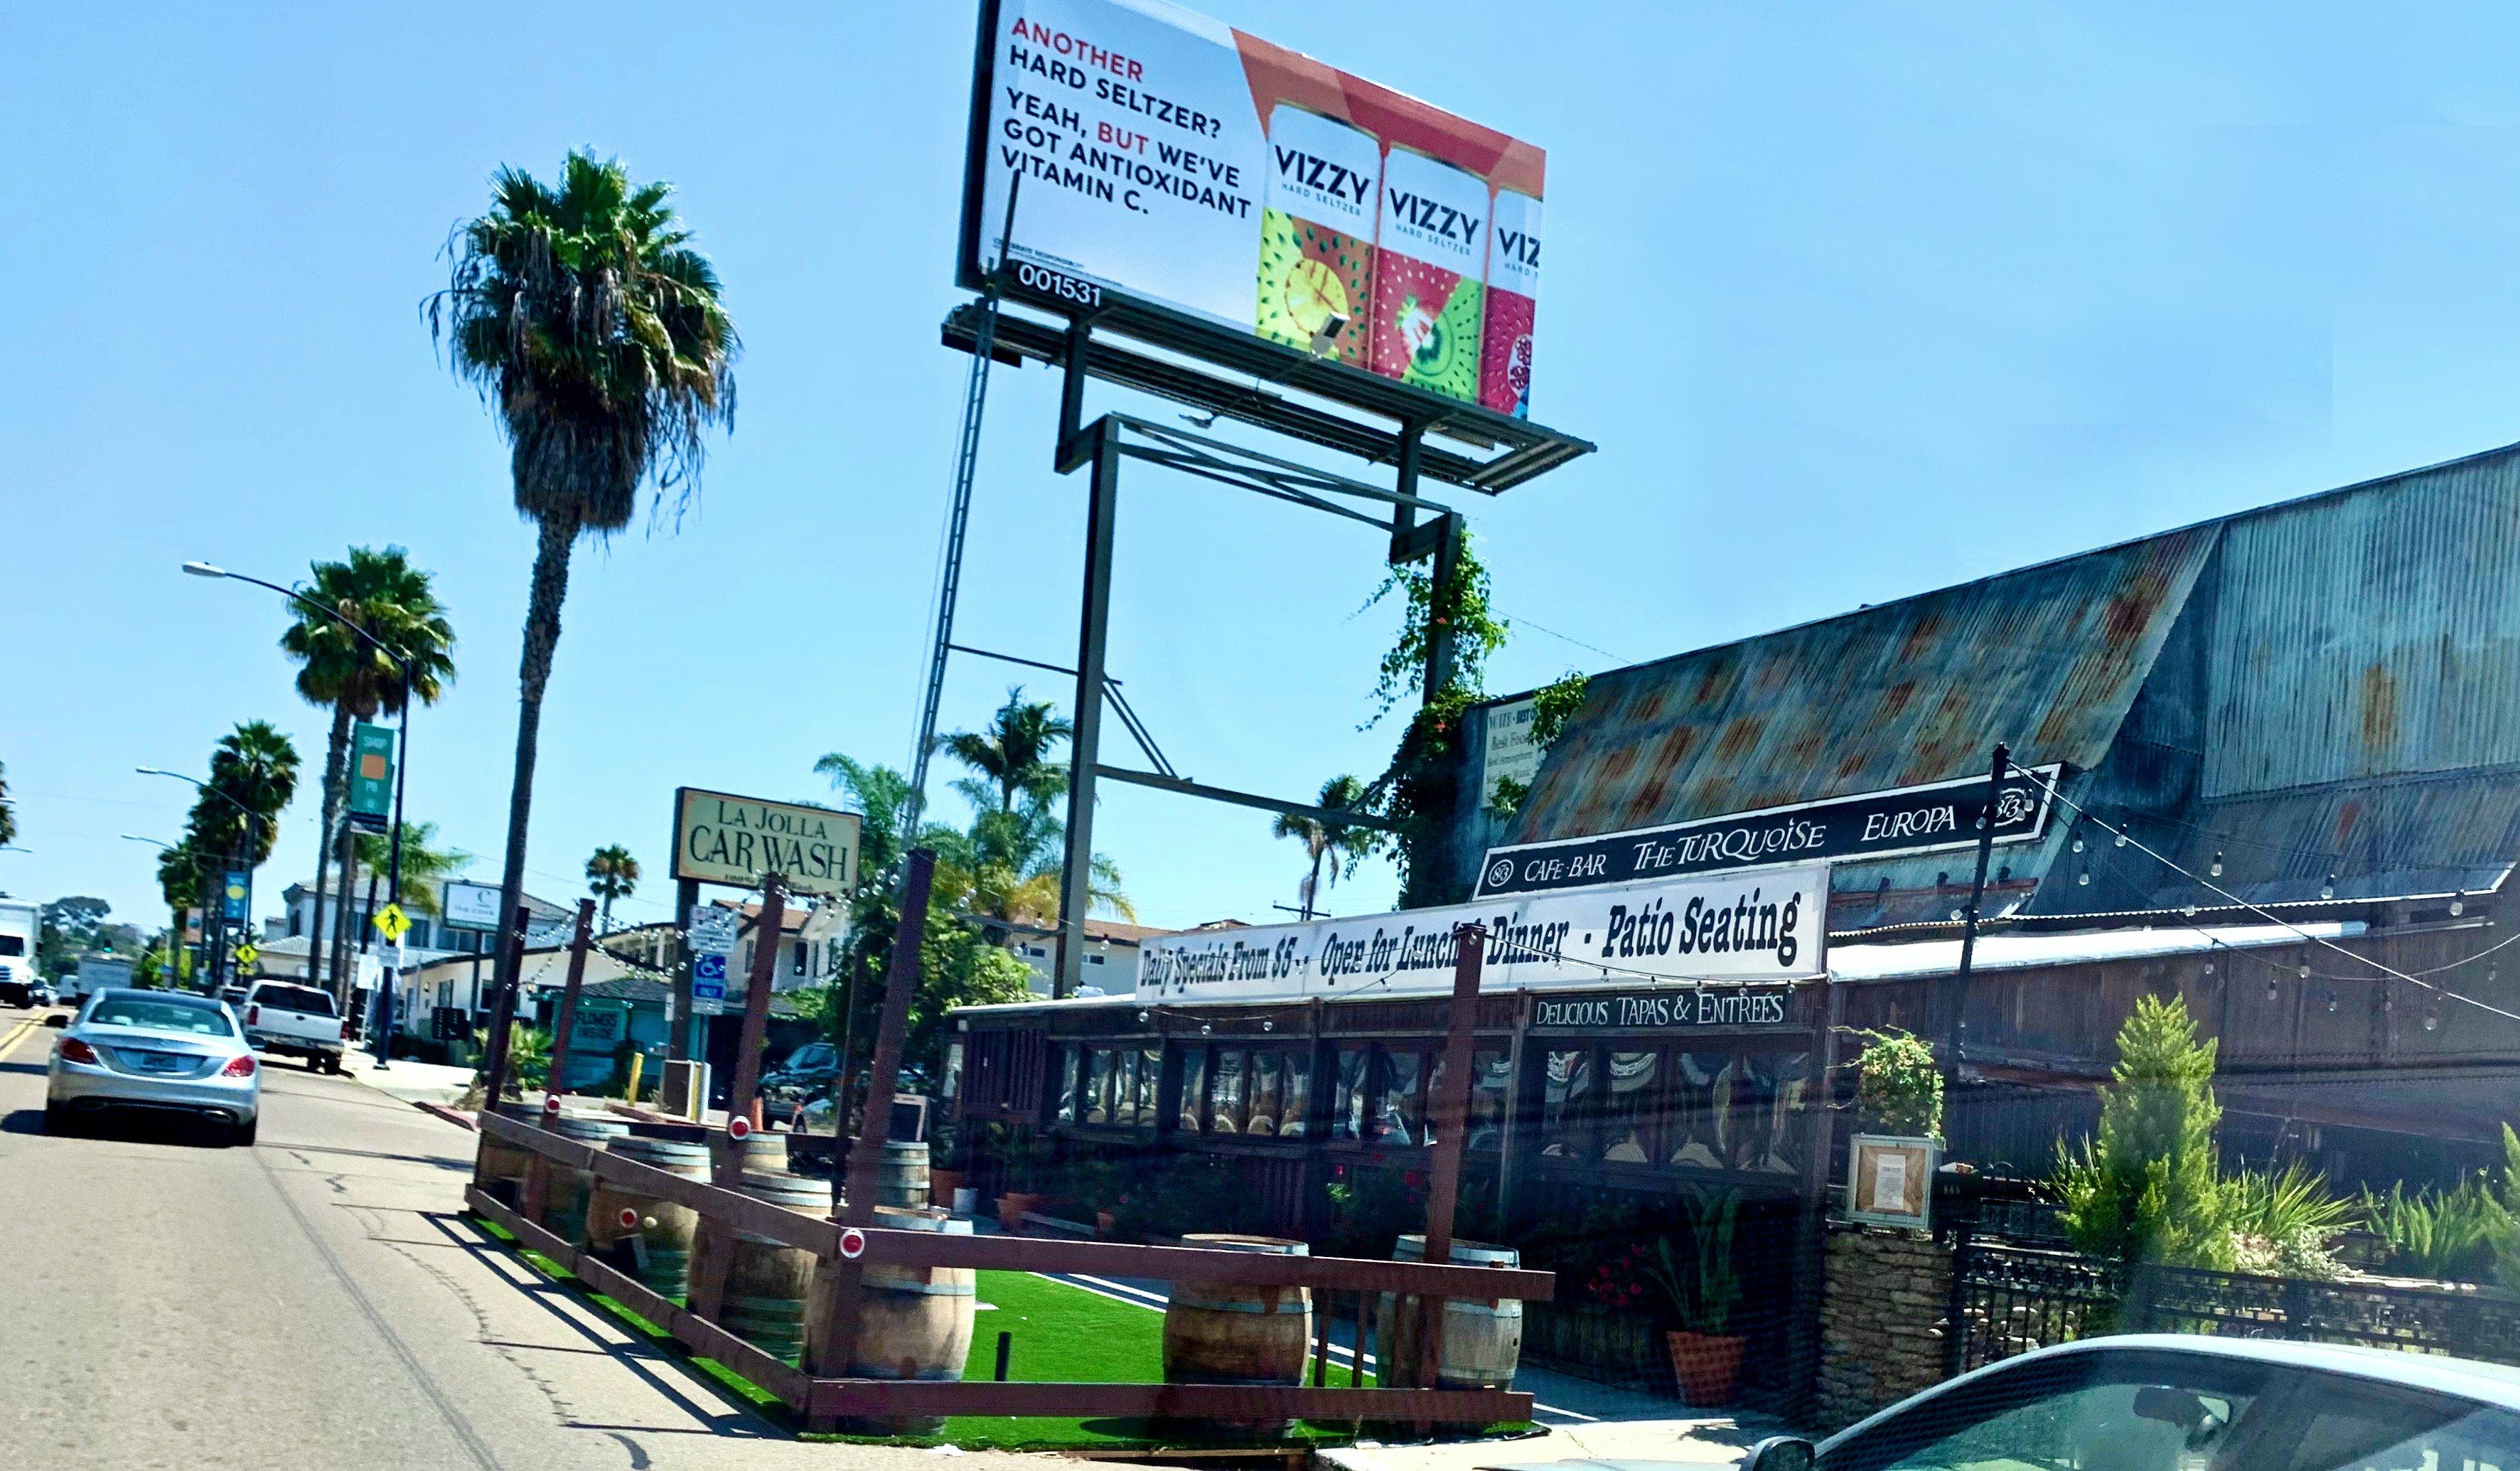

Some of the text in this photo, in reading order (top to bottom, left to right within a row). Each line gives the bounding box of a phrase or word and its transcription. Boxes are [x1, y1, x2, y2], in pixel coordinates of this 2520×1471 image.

[1012, 17, 1143, 84] ANOTHER
[1009, 44, 1221, 139] HARD SELTZER?
[1007, 86, 1240, 188] YEAH, BUT WE'VE
[1001, 144, 1149, 214] VITAMIN C.
[1004, 118, 1251, 219] GOT ANTIOXIDANT
[1275, 144, 1371, 205] VIZZY
[1282, 182, 1361, 216] HARD SELTZER
[1389, 188, 1479, 245] VIZZY
[1395, 223, 1471, 256] HARD SELTZER
[1019, 264, 1101, 307] 001531
[717, 800, 828, 840] LA JOLLA
[1633, 840, 1676, 871] THE
[1860, 805, 1956, 842] EUROPA
[689, 825, 849, 882] CAR WASH
[1140, 947, 1174, 996] Daily
[1174, 941, 1229, 994] Specials
[1228, 941, 1270, 982] From
[1272, 934, 1299, 982] $5
[1320, 931, 1366, 986] Open
[1365, 927, 1398, 973] for
[1396, 921, 1461, 971] Lunch
[1486, 911, 1570, 966] Dinner
[1602, 897, 1675, 958] Patio
[1678, 887, 1802, 968] Seating
[1535, 1001, 1609, 1026] DELICIOUS
[1616, 997, 1670, 1026] TAPAS
[1673, 995, 1692, 1021] &
